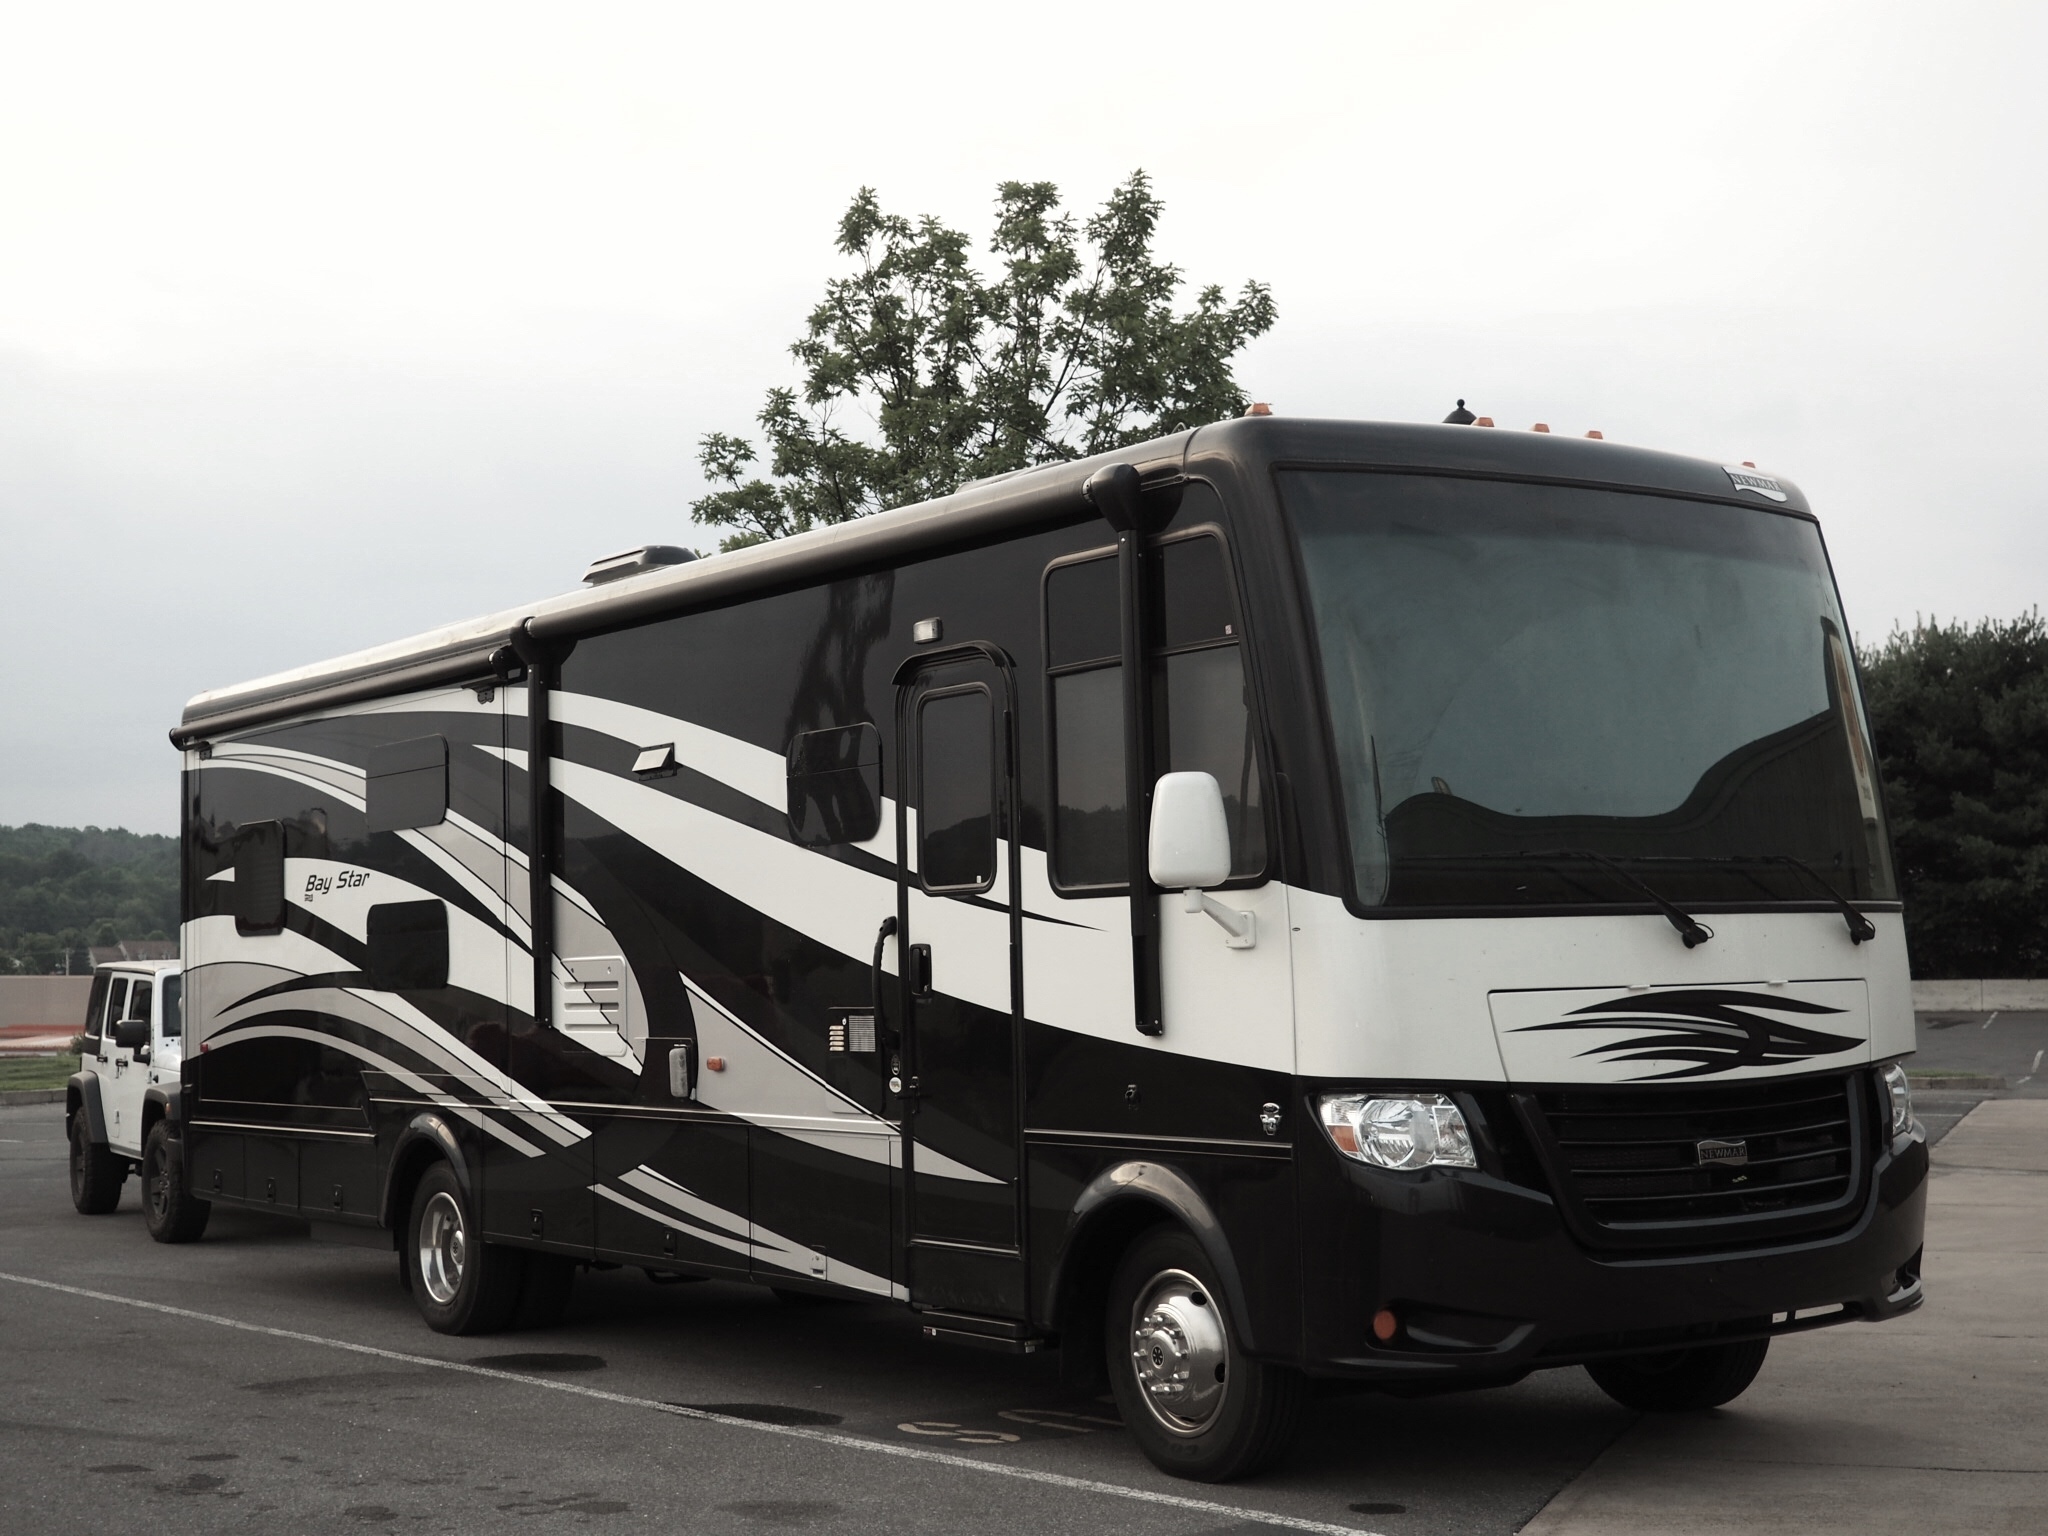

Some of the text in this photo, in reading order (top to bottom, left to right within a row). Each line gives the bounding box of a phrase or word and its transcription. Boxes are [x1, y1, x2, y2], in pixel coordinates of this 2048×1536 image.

[1730, 474, 1782, 492] NEWMAR
[305, 870, 370, 895] Bay Star
[1700, 1147, 1747, 1160] NEWMAR
